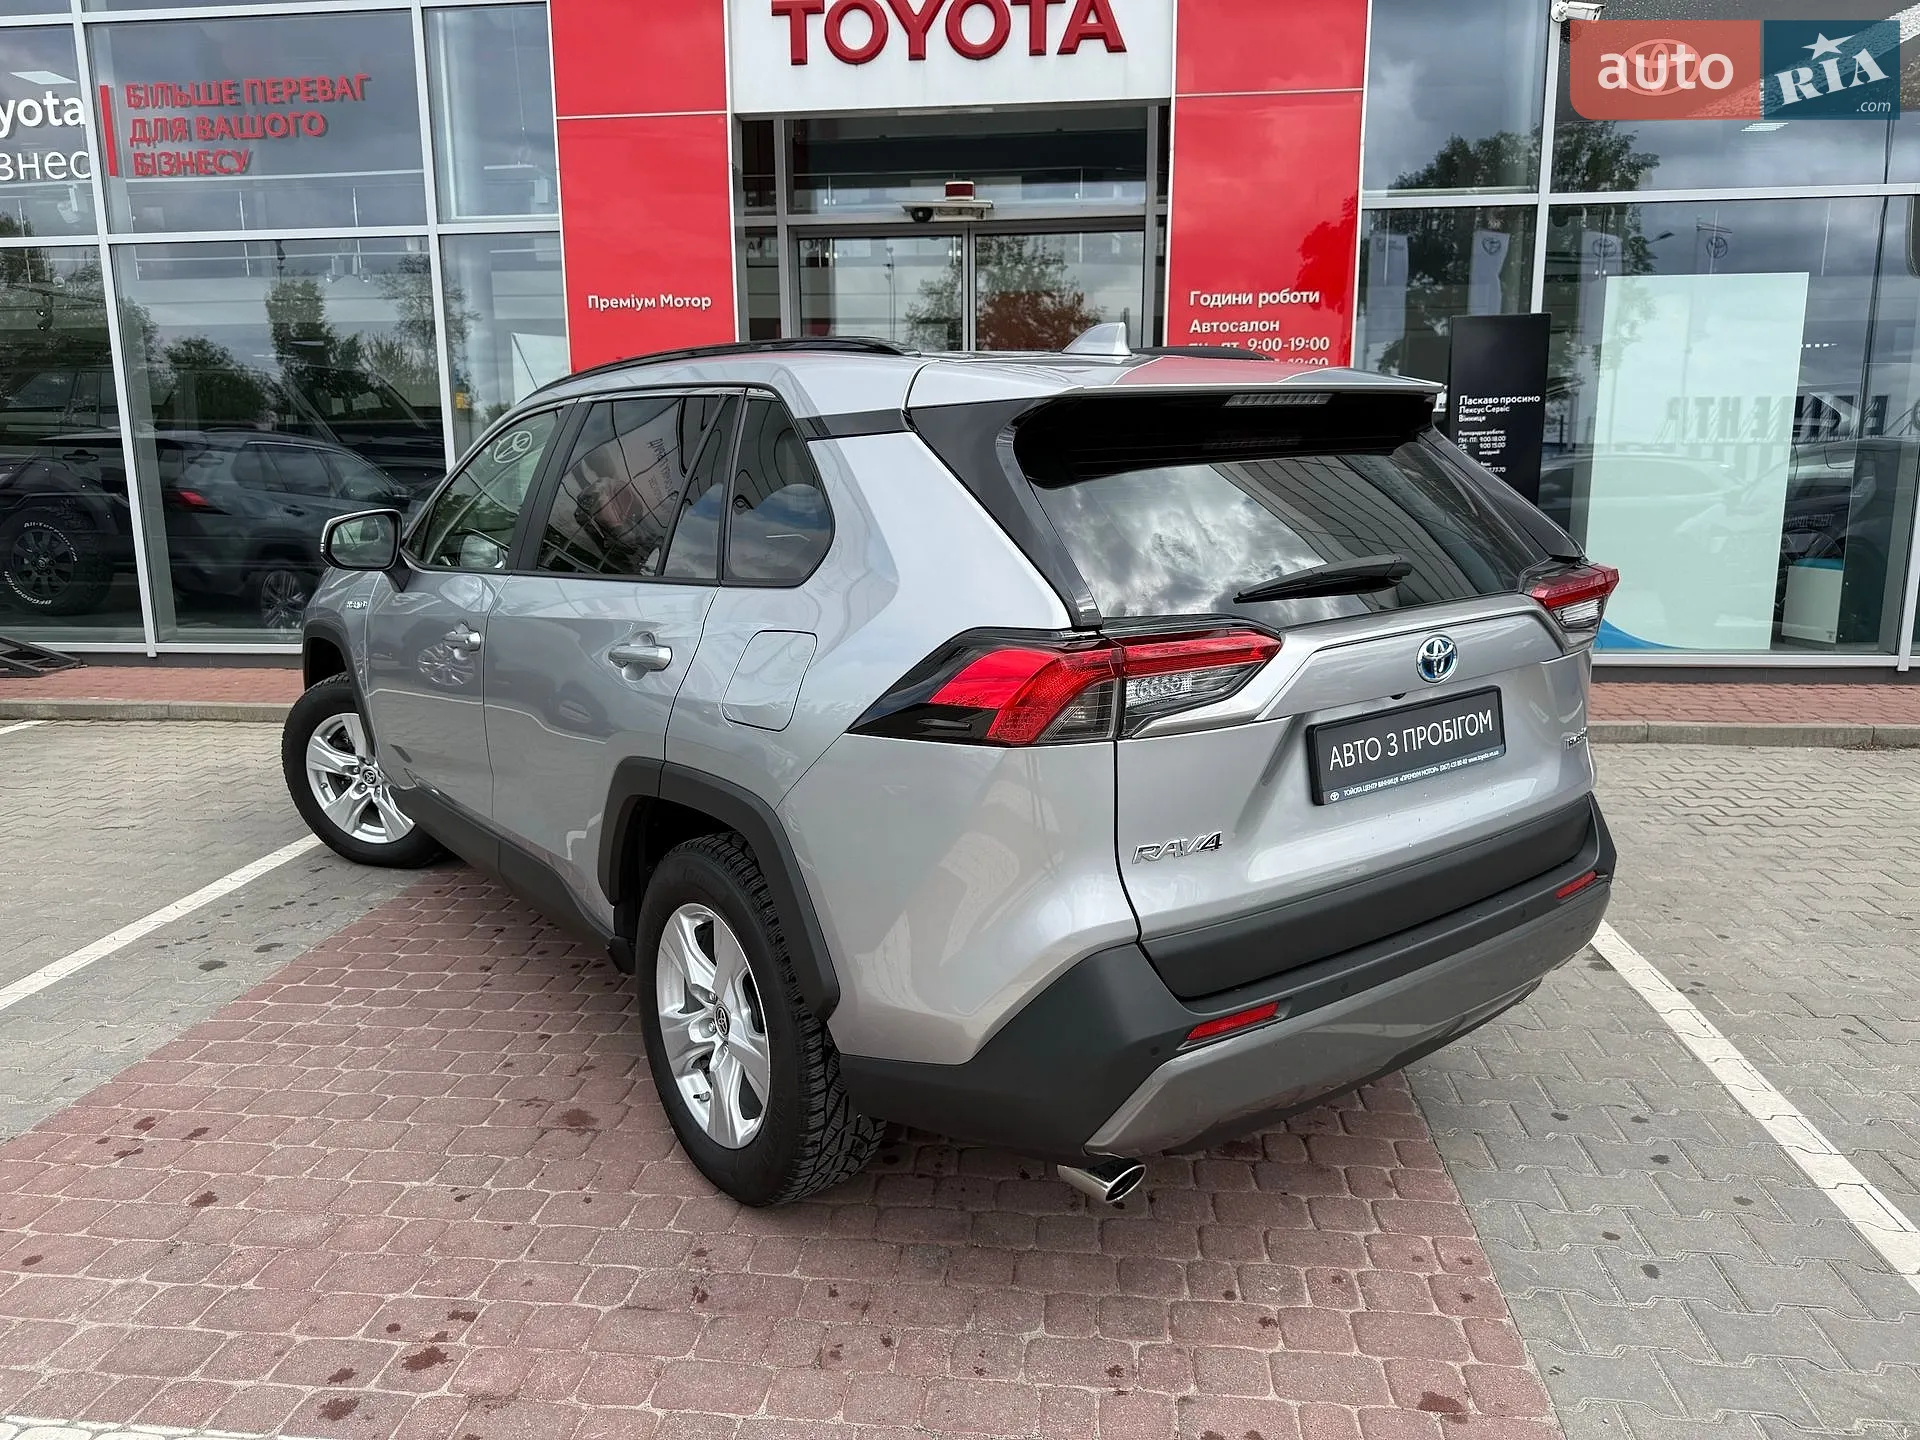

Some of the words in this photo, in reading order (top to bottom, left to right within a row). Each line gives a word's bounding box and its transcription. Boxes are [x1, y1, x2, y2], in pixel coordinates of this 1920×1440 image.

[771, 0, 1128, 65] TOYOTA
[125, 80, 236, 108] БІЛЬШЕ
[244, 73, 370, 104] ПЕРЕВАГ
[128, 116, 189, 147] ДЛЯ
[197, 111, 327, 141] ВАШОГО
[132, 149, 251, 176] БІЗНЕСУ
[587, 294, 656, 311] Преміум
[660, 294, 712, 311] Мотор
[1189, 290, 1253, 307] Години
[1258, 288, 1321, 308] роботи
[1189, 319, 1280, 333] Автосалон
[1247, 336, 1330, 352] 9:00-19:00
[1459, 395, 1499, 405] Ласкаво
[1500, 395, 1540, 405] просимо
[1459, 405, 1485, 414] Лексус
[1329, 737, 1381, 771] АВТО
[1386, 732, 1399, 756] З
[1402, 709, 1493, 753] ПРОБІГОМ
[1132, 831, 1224, 864] RAV4
